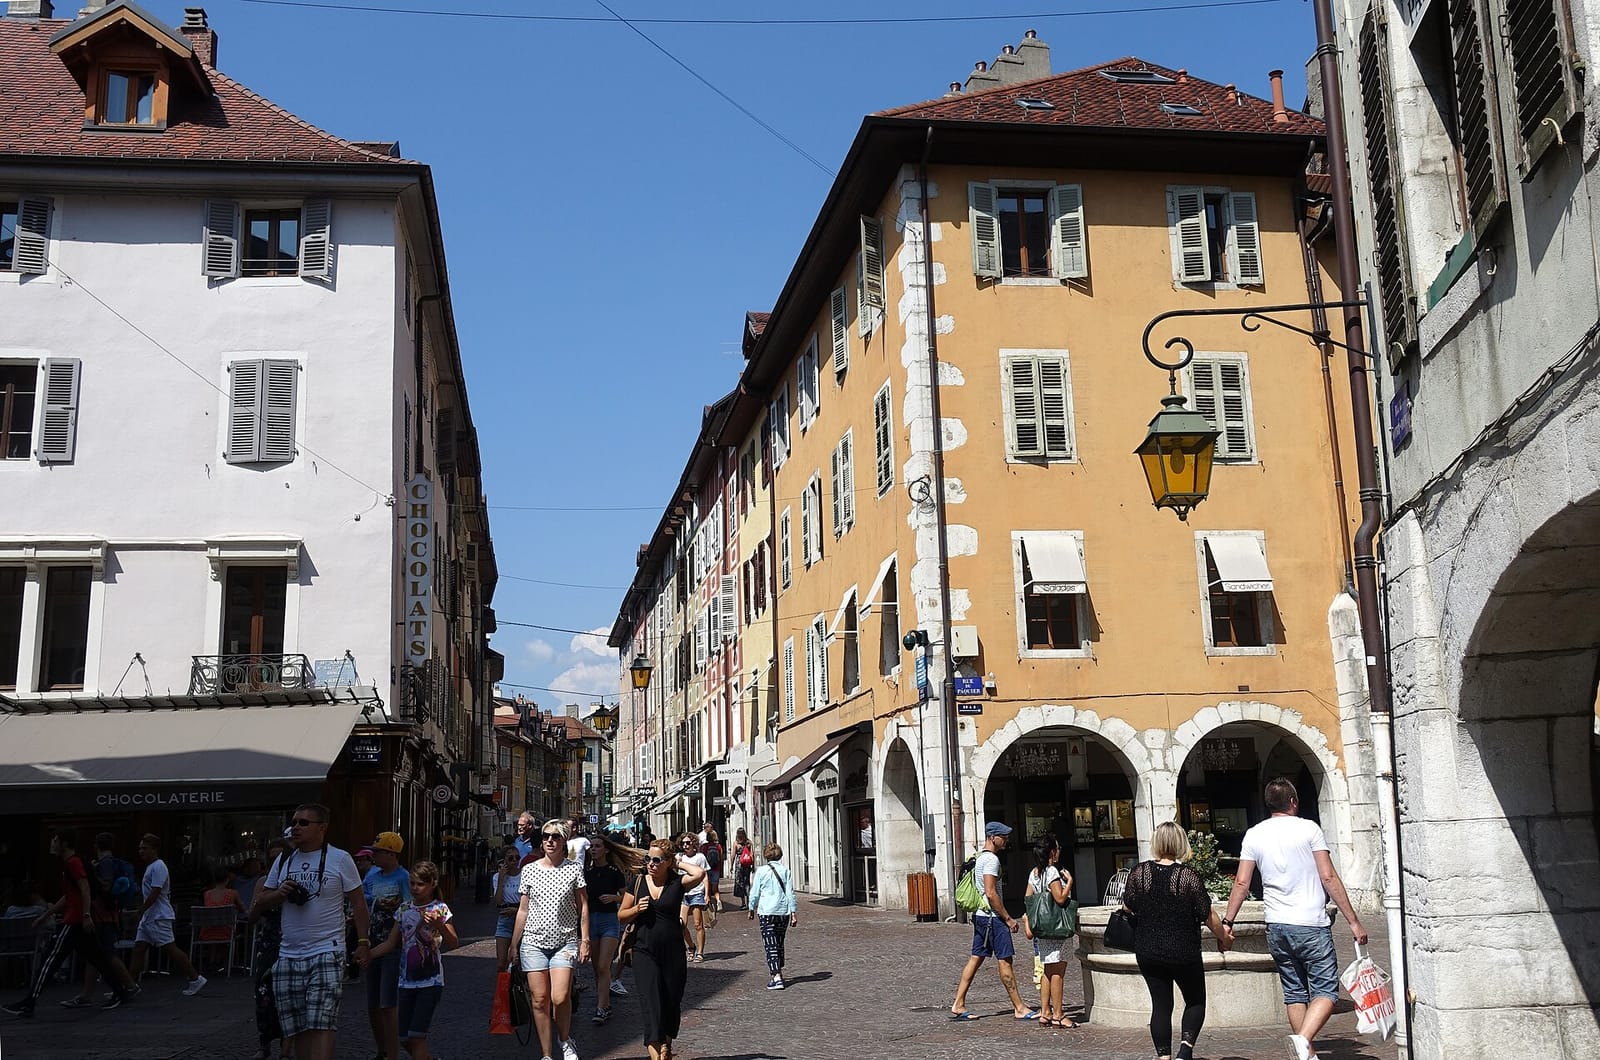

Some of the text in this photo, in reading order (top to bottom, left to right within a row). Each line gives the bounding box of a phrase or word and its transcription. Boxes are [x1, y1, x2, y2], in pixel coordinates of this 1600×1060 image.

[409, 484, 429, 657] CHOCOLATS
[1224, 582, 1272, 591] Sandwiches
[96, 791, 225, 806] CHOCOLATERIE
